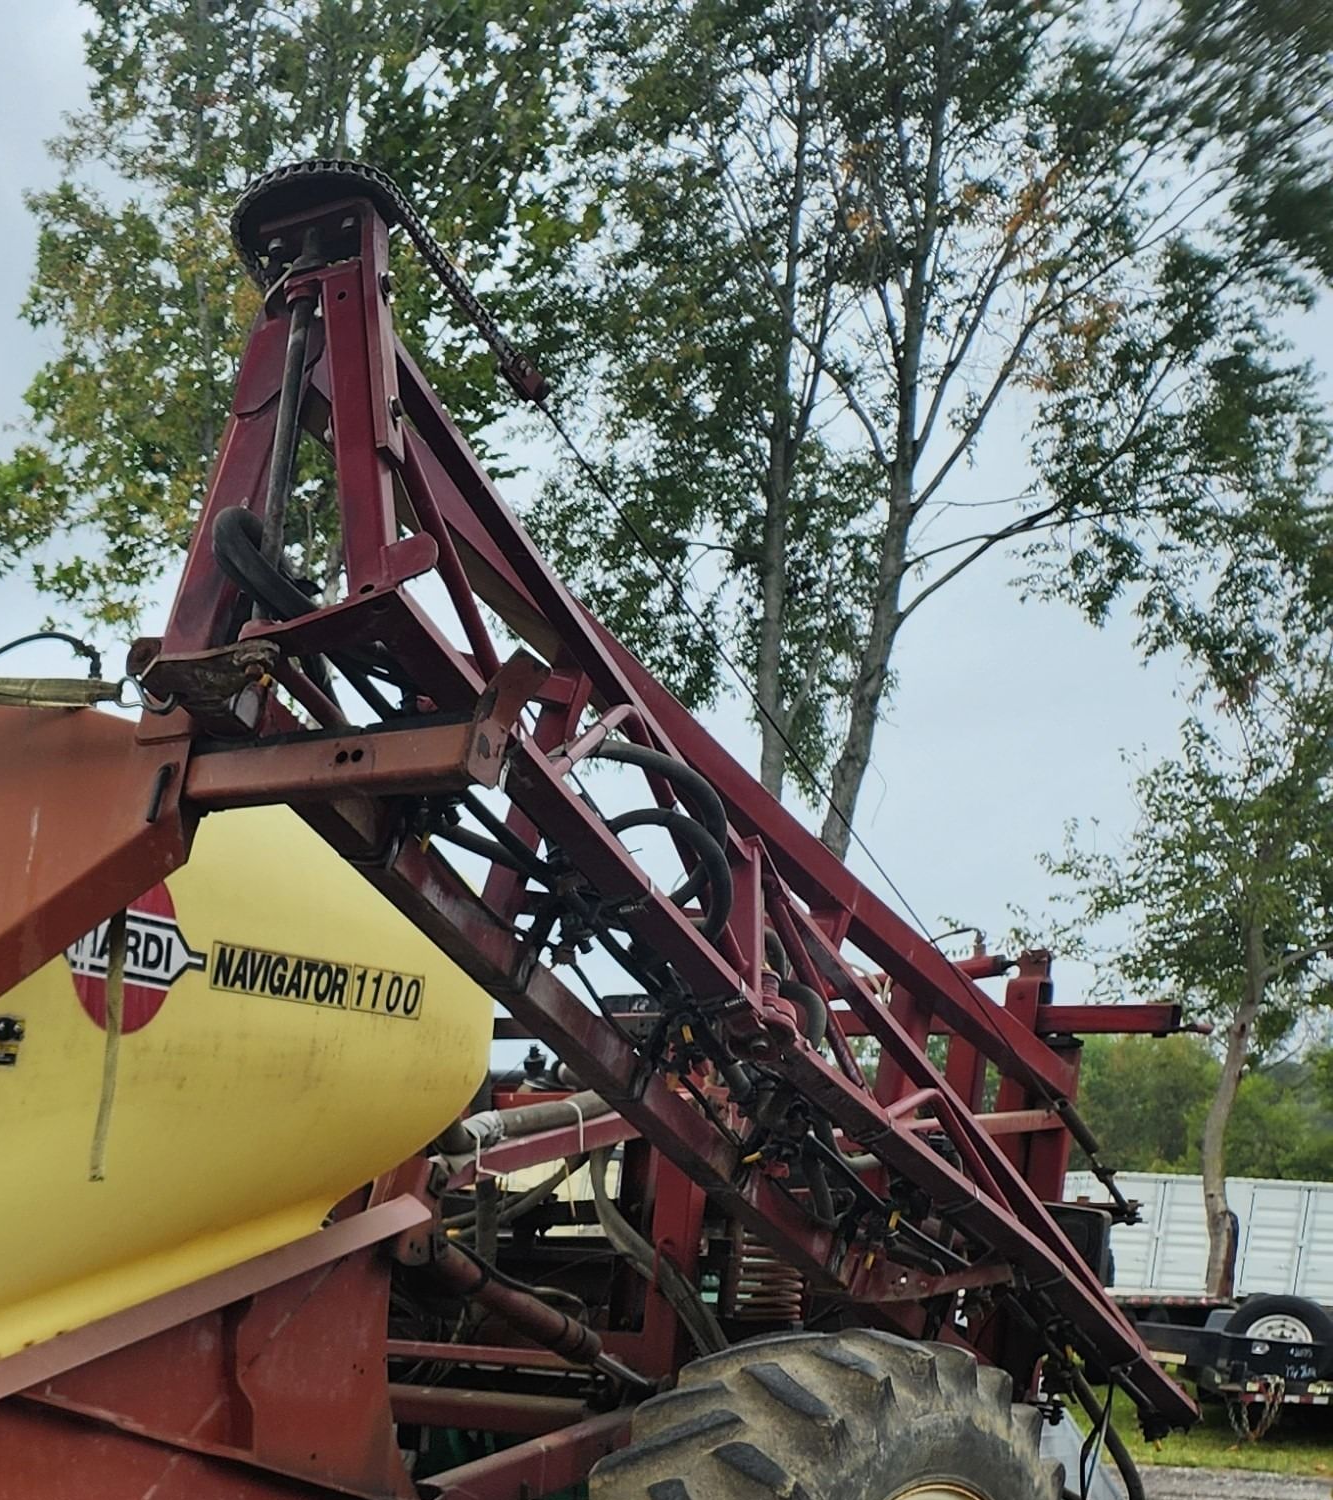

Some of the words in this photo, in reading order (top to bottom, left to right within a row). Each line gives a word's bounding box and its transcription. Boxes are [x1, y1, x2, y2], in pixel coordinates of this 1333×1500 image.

[75, 928, 174, 974] RDI
[212, 946, 349, 1006] NAVIGATOR
[355, 968, 421, 1016] 1100
